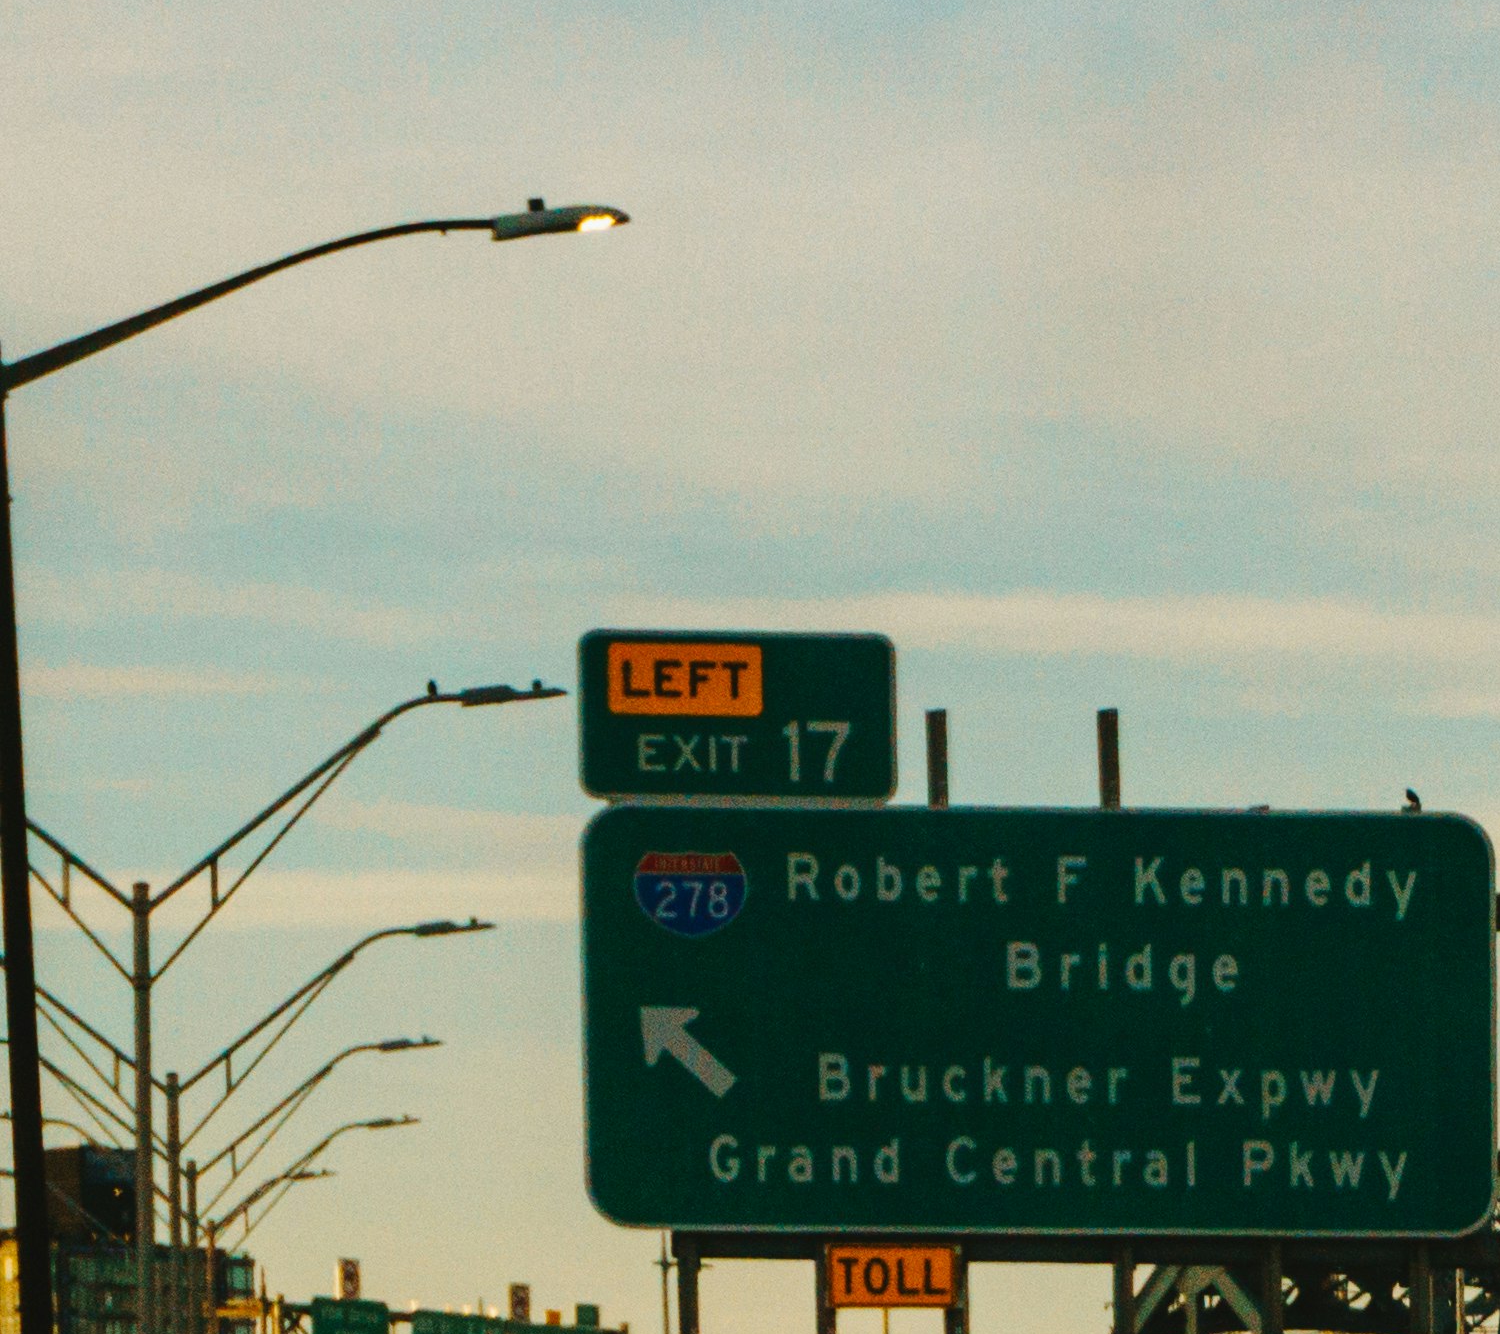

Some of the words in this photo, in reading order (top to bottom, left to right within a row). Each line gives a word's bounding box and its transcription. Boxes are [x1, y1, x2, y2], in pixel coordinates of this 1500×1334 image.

[621, 659, 749, 700] LEFT
[637, 734, 748, 772] EXIT
[782, 720, 851, 782] 17
[655, 881, 729, 919] 278
[787, 852, 1009, 904] Robert
[1057, 855, 1087, 904] F
[1134, 857, 1417, 920] Kennedy
[1006, 941, 1239, 1006] Bridge
[818, 1052, 1127, 1105] Bruckner
[1171, 1057, 1379, 1119] Expwy
[709, 1134, 900, 1184] Grand
[945, 1135, 1196, 1187] Central
[1242, 1139, 1408, 1200] Pkwy
[837, 1257, 948, 1296] TOLL
